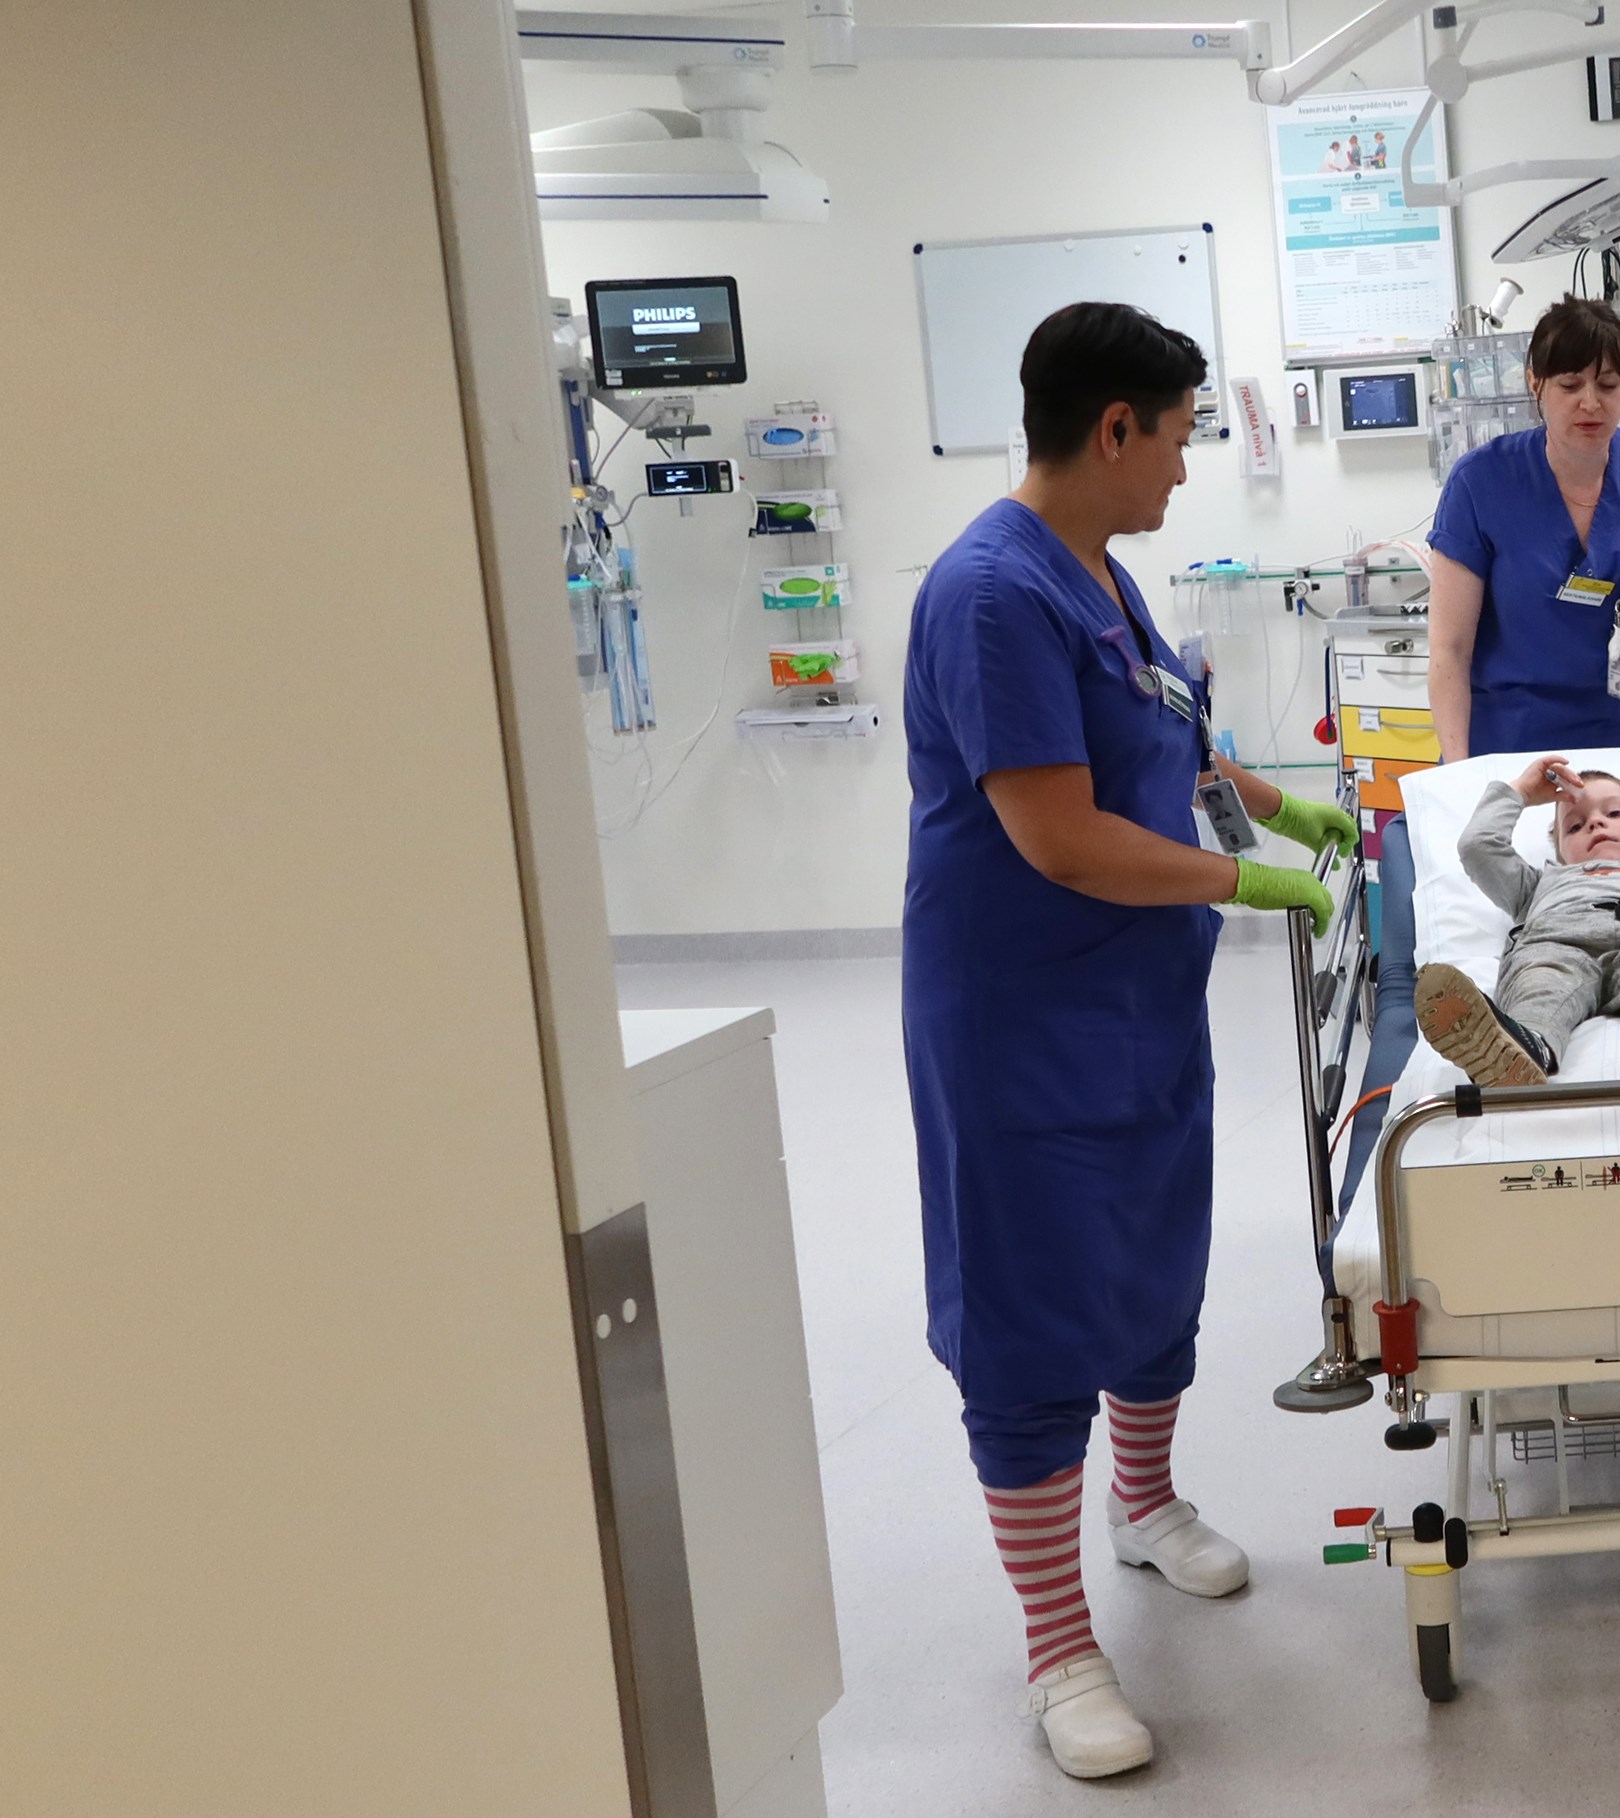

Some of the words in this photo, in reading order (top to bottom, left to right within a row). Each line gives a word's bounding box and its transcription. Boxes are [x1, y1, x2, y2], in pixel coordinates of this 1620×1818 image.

[1298, 105, 1331, 115] Avancerad
[632, 306, 697, 322] PHILIPS
[1239, 384, 1260, 431] TRAUMA
[1252, 433, 1266, 458] nivå
